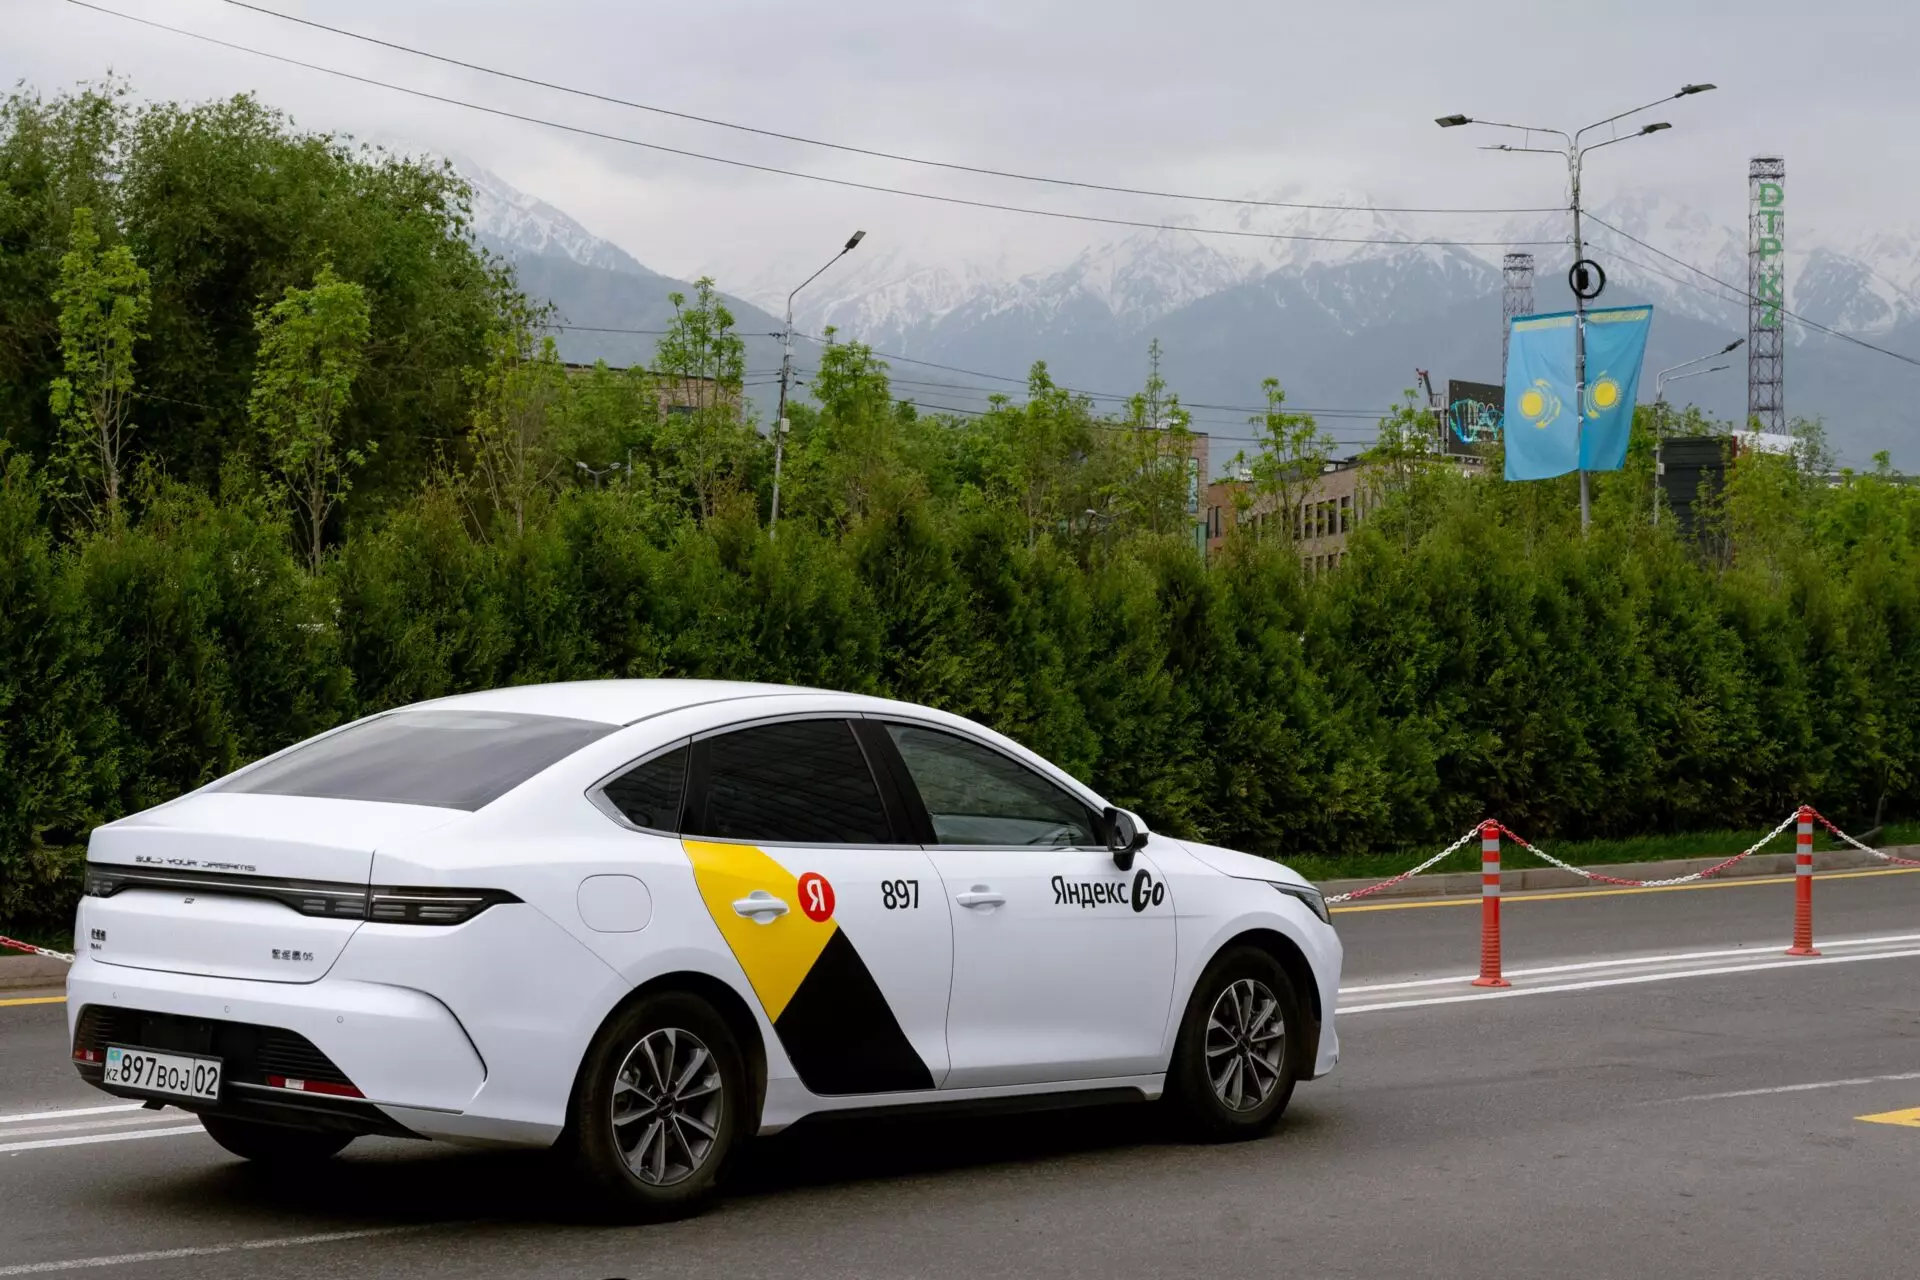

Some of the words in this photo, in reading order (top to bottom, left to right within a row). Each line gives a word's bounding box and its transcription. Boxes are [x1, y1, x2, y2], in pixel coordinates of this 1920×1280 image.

[167, 858, 197, 866] YOUR
[202, 861, 256, 872] DREAMS
[806, 879, 826, 911] Я
[881, 879, 919, 910] 897
[1051, 875, 1129, 908] Яндекс
[1131, 868, 1165, 913] Go
[106, 1067, 119, 1082] KZ
